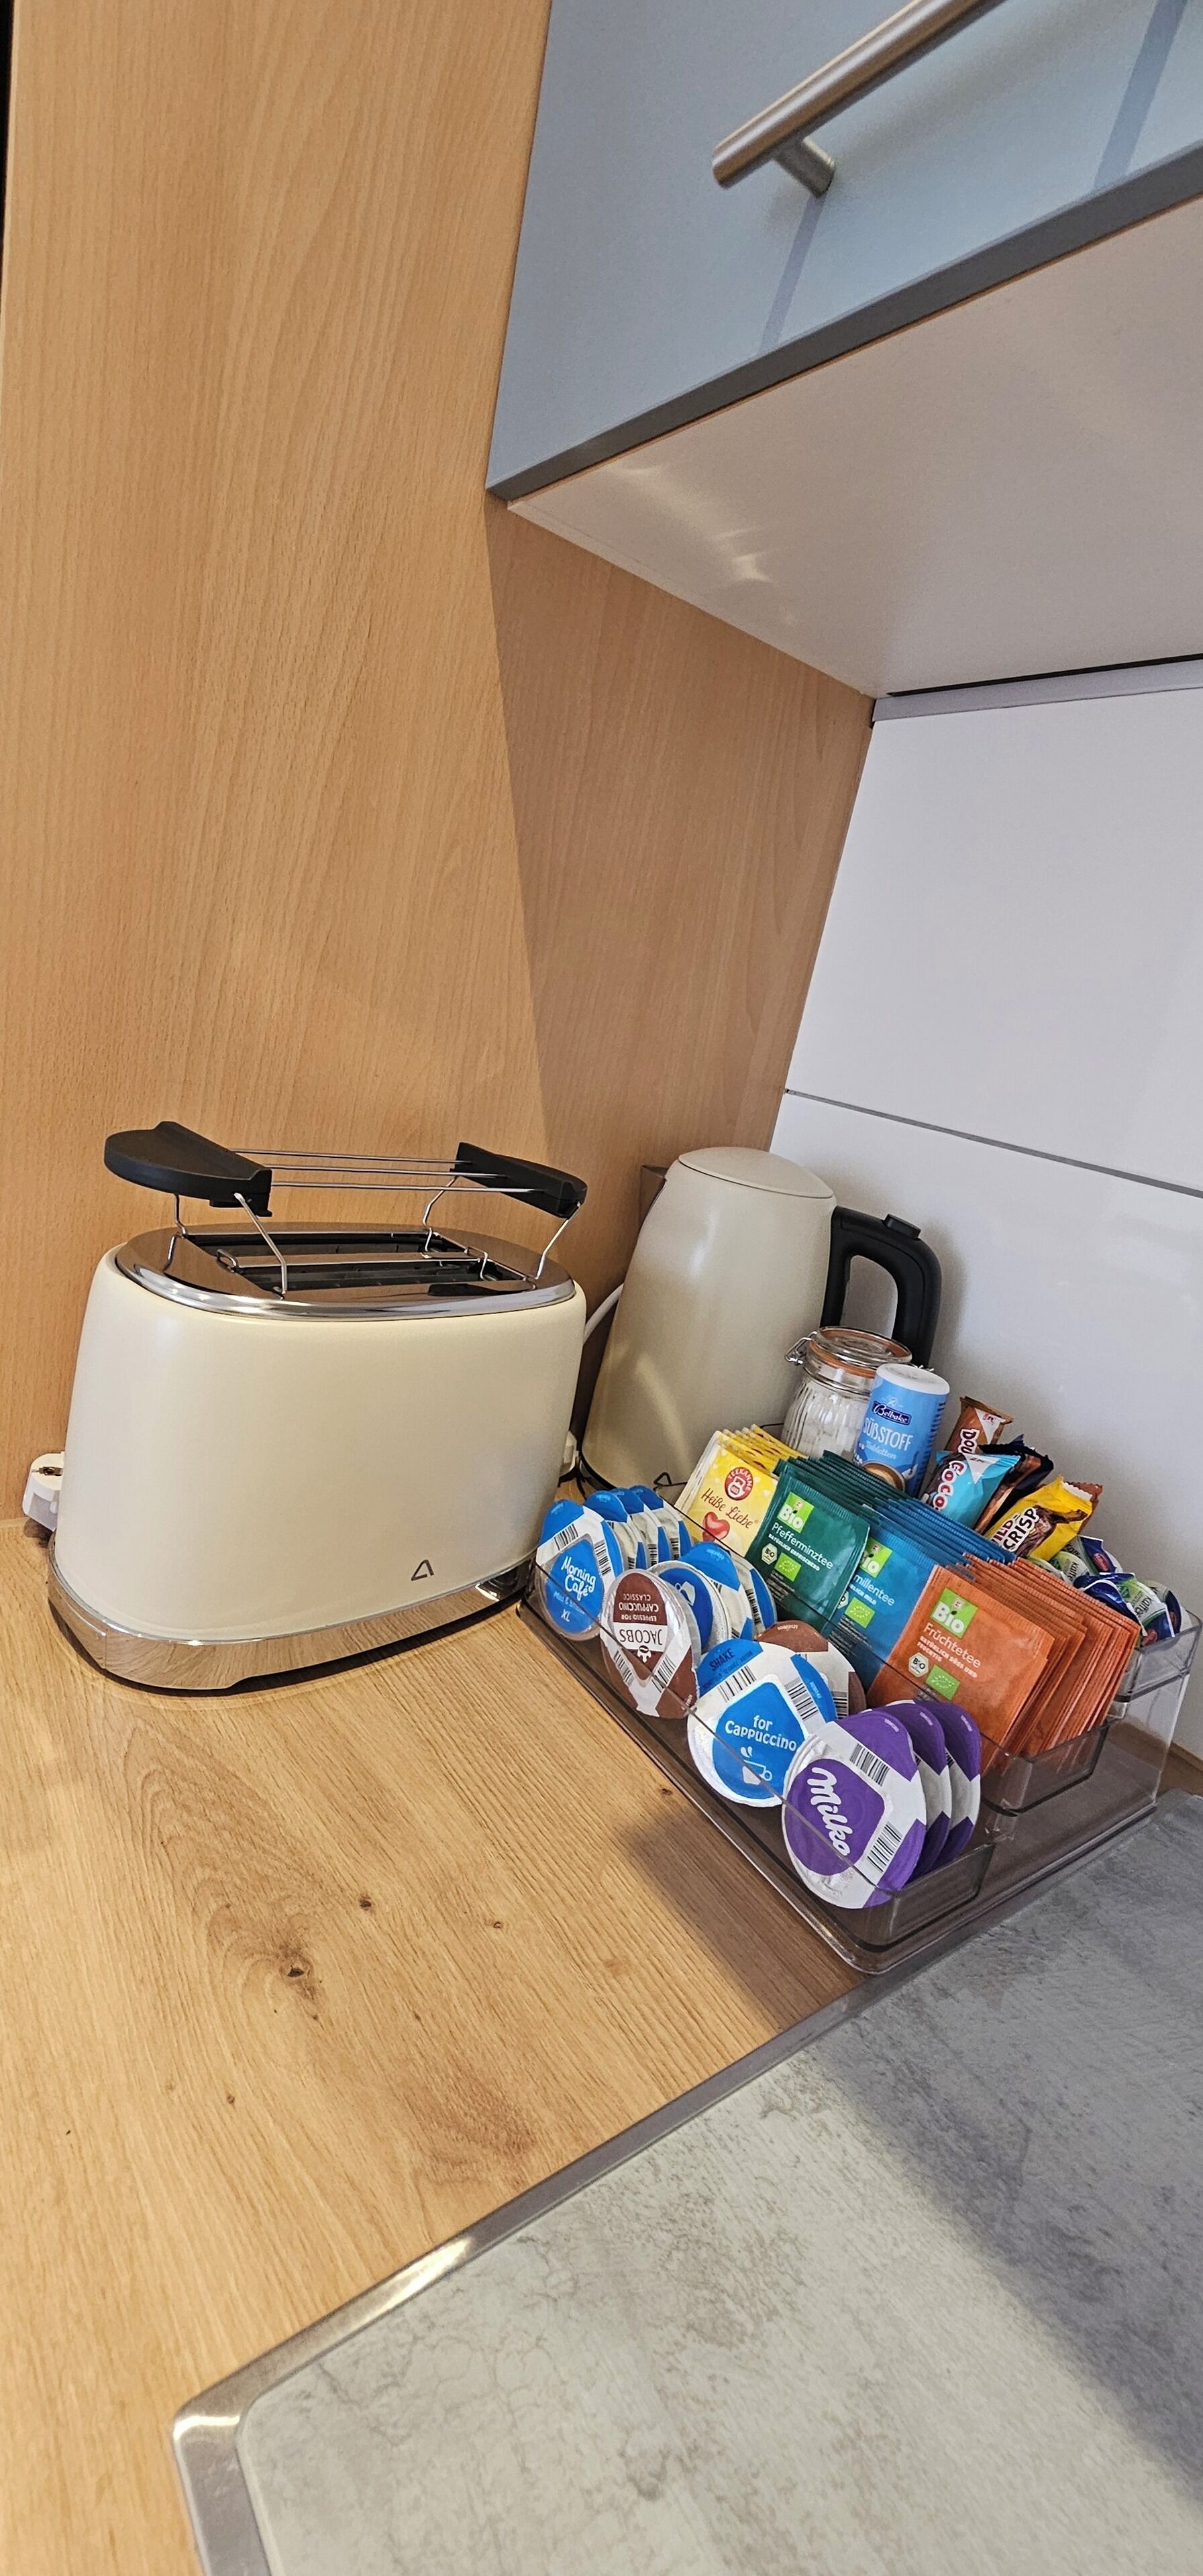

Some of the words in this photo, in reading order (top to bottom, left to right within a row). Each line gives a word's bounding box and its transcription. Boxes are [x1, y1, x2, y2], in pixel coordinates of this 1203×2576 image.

[874, 1403, 908, 1423] Belbake
[727, 1467, 752, 1491] TEEKANNE
[701, 1488, 727, 1512] Heiße
[725, 1505, 754, 1529] Liebe
[1003, 1508, 1037, 1550] CRISP
[772, 1522, 834, 1570] Pfefferminztee
[561, 1556, 596, 1593] Morning
[565, 1574, 588, 1601] Café
[561, 1608, 570, 1622] XL
[619, 1602, 660, 1613] CAPPUCCINO
[633, 1614, 658, 1622] ESPRESSO
[619, 1629, 664, 1646] JACOBS
[923, 1622, 981, 1668] Früchtetee
[709, 1648, 735, 1672] SHAKE
[725, 1721, 797, 1750] Cappuccino
[753, 1715, 773, 1731] for
[806, 1766, 853, 1856] Milka
